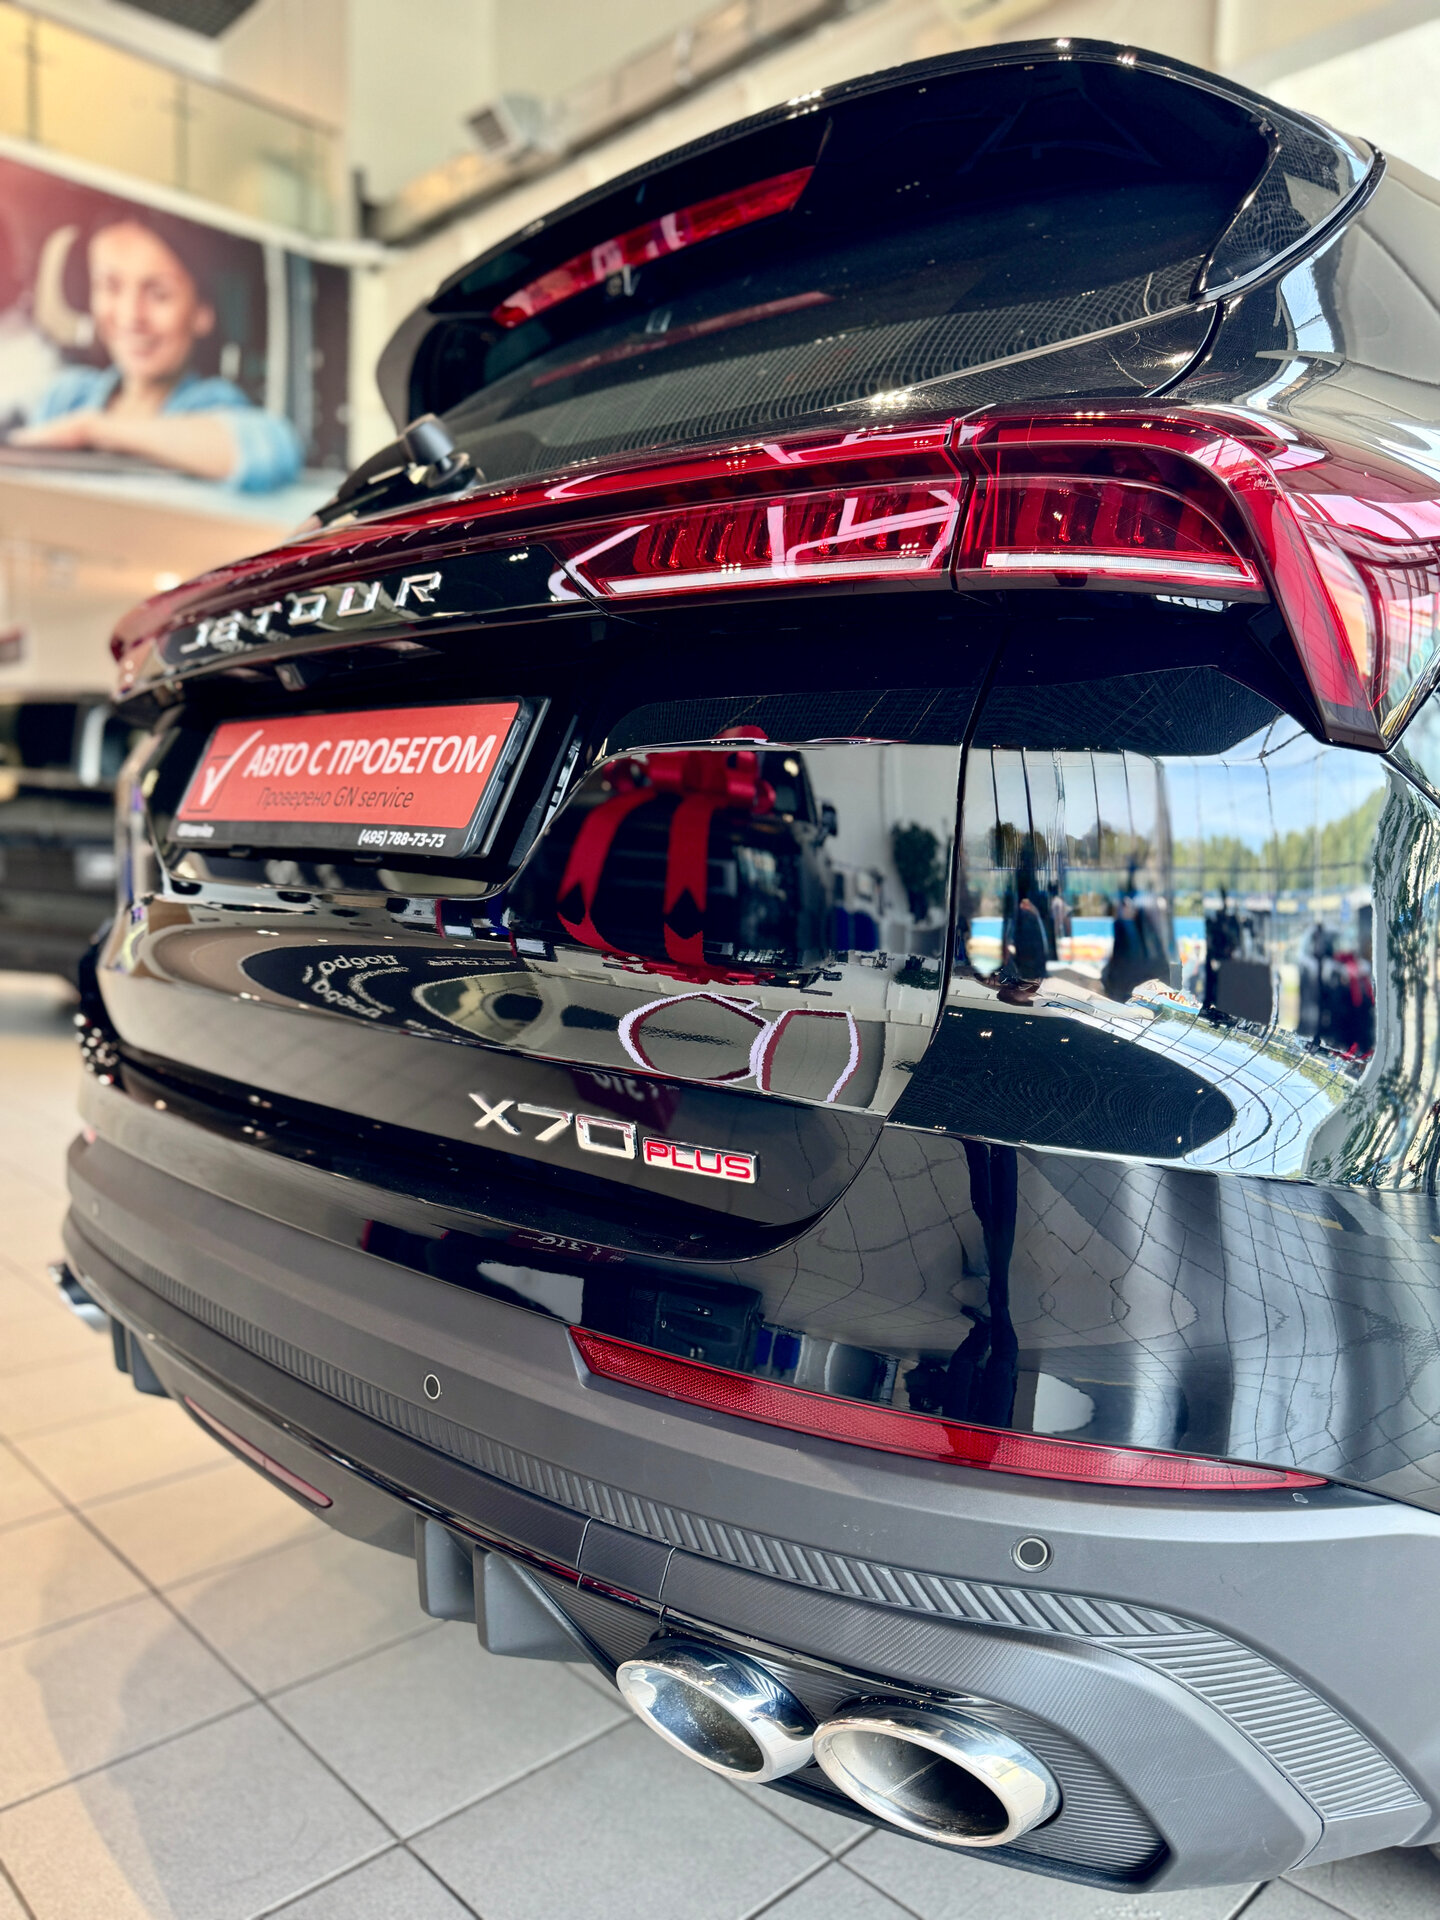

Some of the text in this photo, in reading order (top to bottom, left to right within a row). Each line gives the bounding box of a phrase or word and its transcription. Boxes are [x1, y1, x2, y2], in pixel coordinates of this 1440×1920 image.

[180, 571, 442, 654] JETOUR
[243, 735, 497, 778] АВТО С ПРОБЕГОМ
[258, 786, 414, 810] Проверено GN service
[357, 828, 447, 848] (495) 788-73-73
[468, 1092, 753, 1180] X70 PLUS
